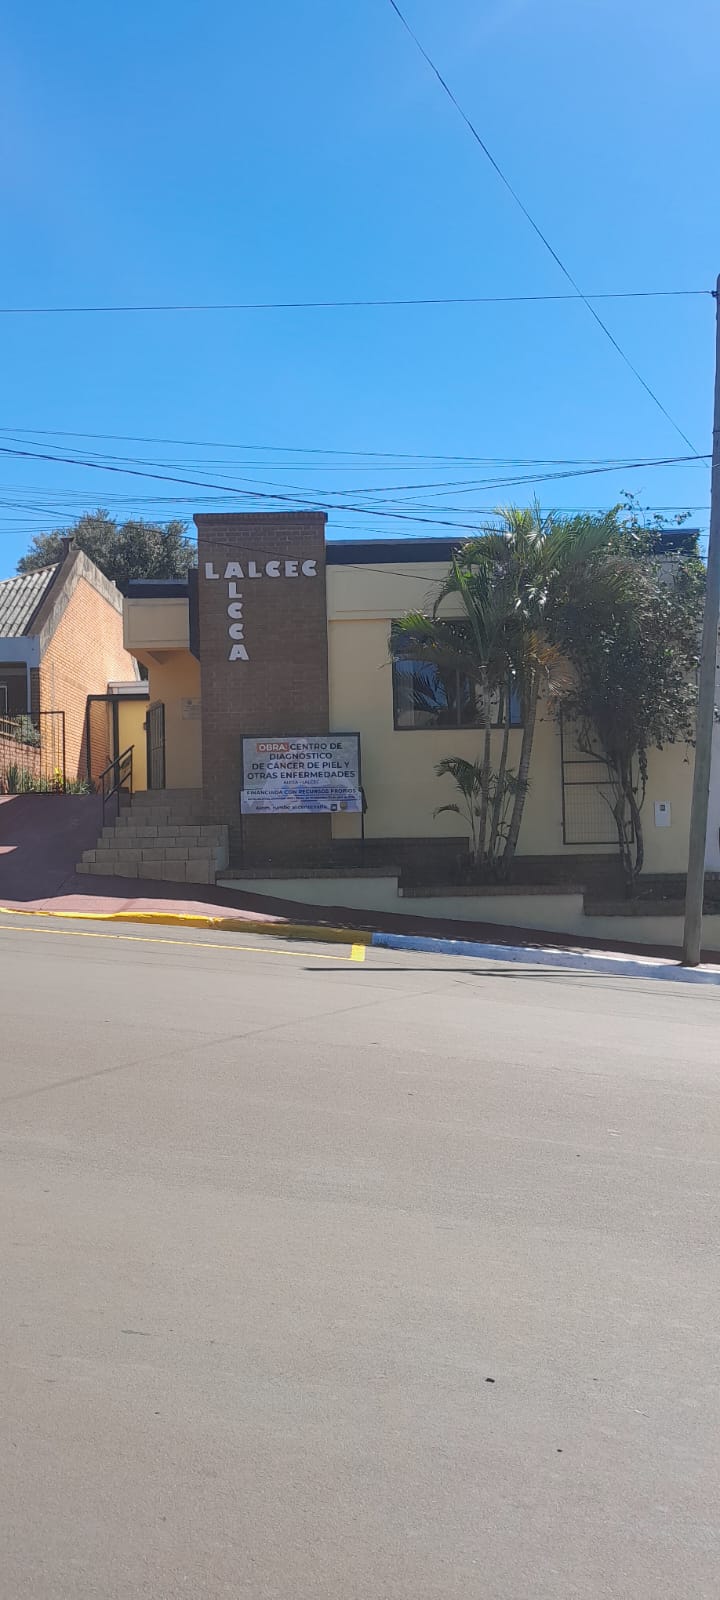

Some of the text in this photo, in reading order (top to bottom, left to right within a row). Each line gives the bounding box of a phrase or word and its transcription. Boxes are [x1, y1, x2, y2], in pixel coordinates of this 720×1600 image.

[205, 560, 317, 579] LALCEC
[330, 742, 343, 750] DE
[307, 761, 321, 769] DE
[247, 771, 355, 780] OTRAS ENFERMEDADES
